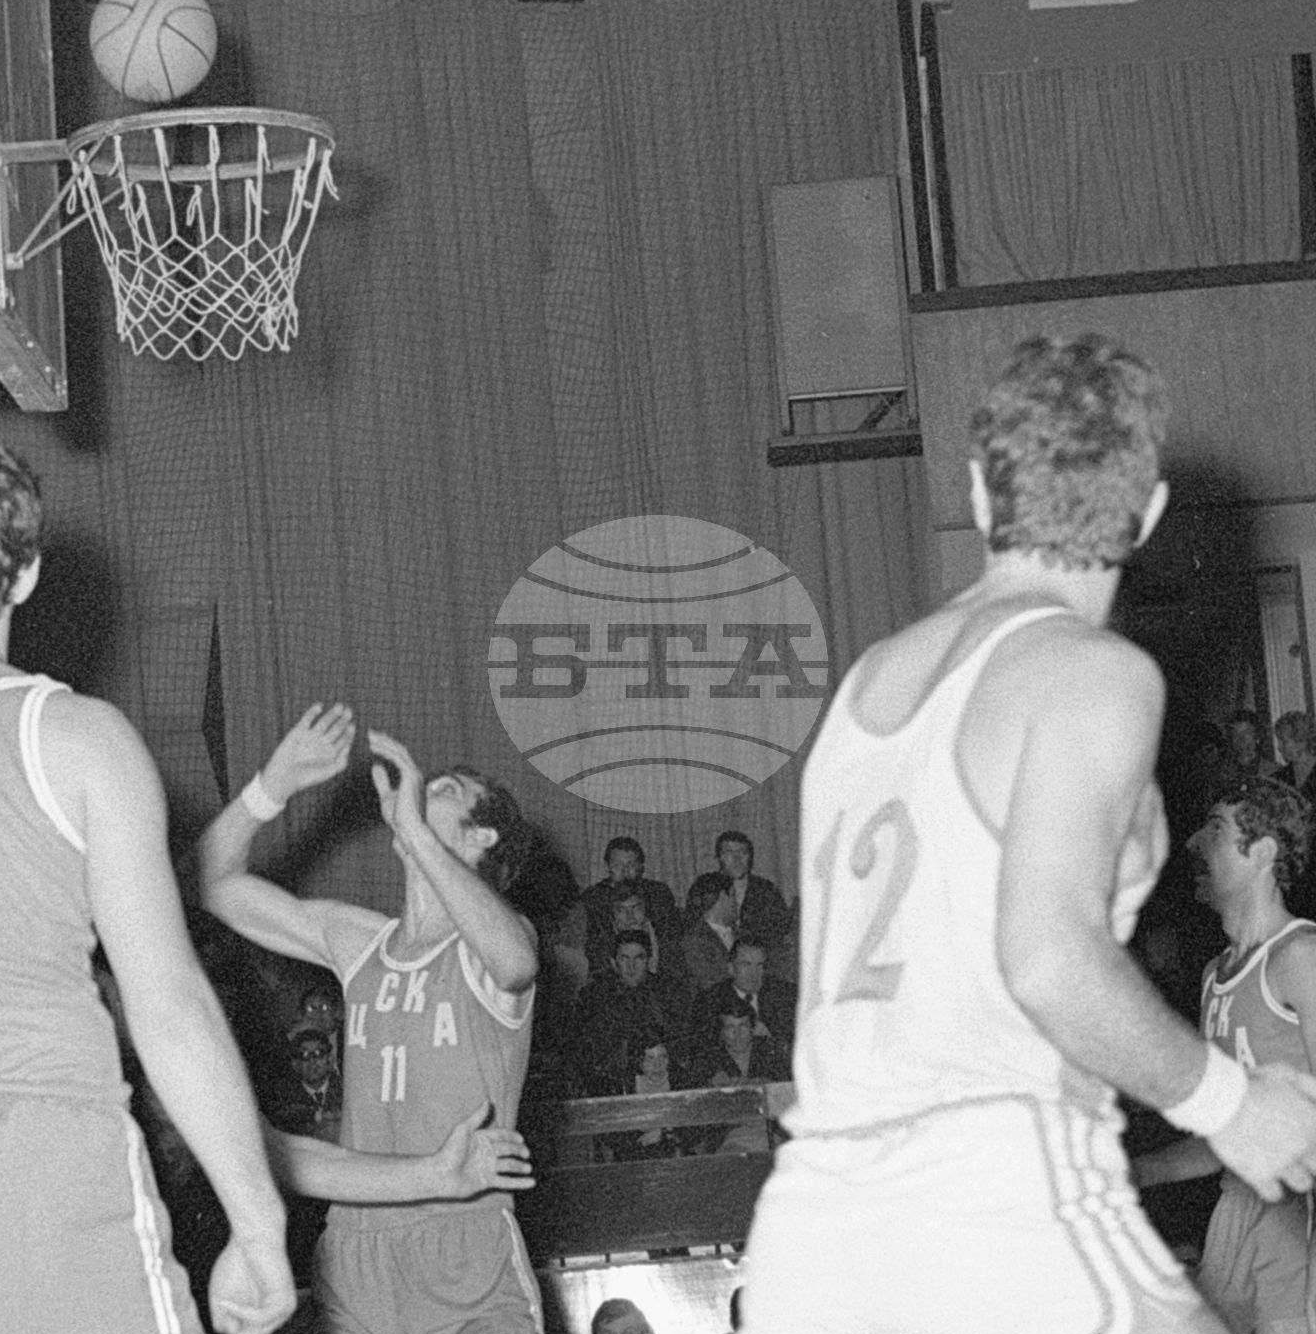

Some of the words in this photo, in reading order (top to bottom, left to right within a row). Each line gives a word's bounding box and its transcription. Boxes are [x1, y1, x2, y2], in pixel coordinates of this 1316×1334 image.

[804, 798, 920, 1013] 12
[348, 970, 459, 1049] ЦСКА
[1205, 995, 1256, 1068] СКА
[381, 1045, 406, 1102] 11
